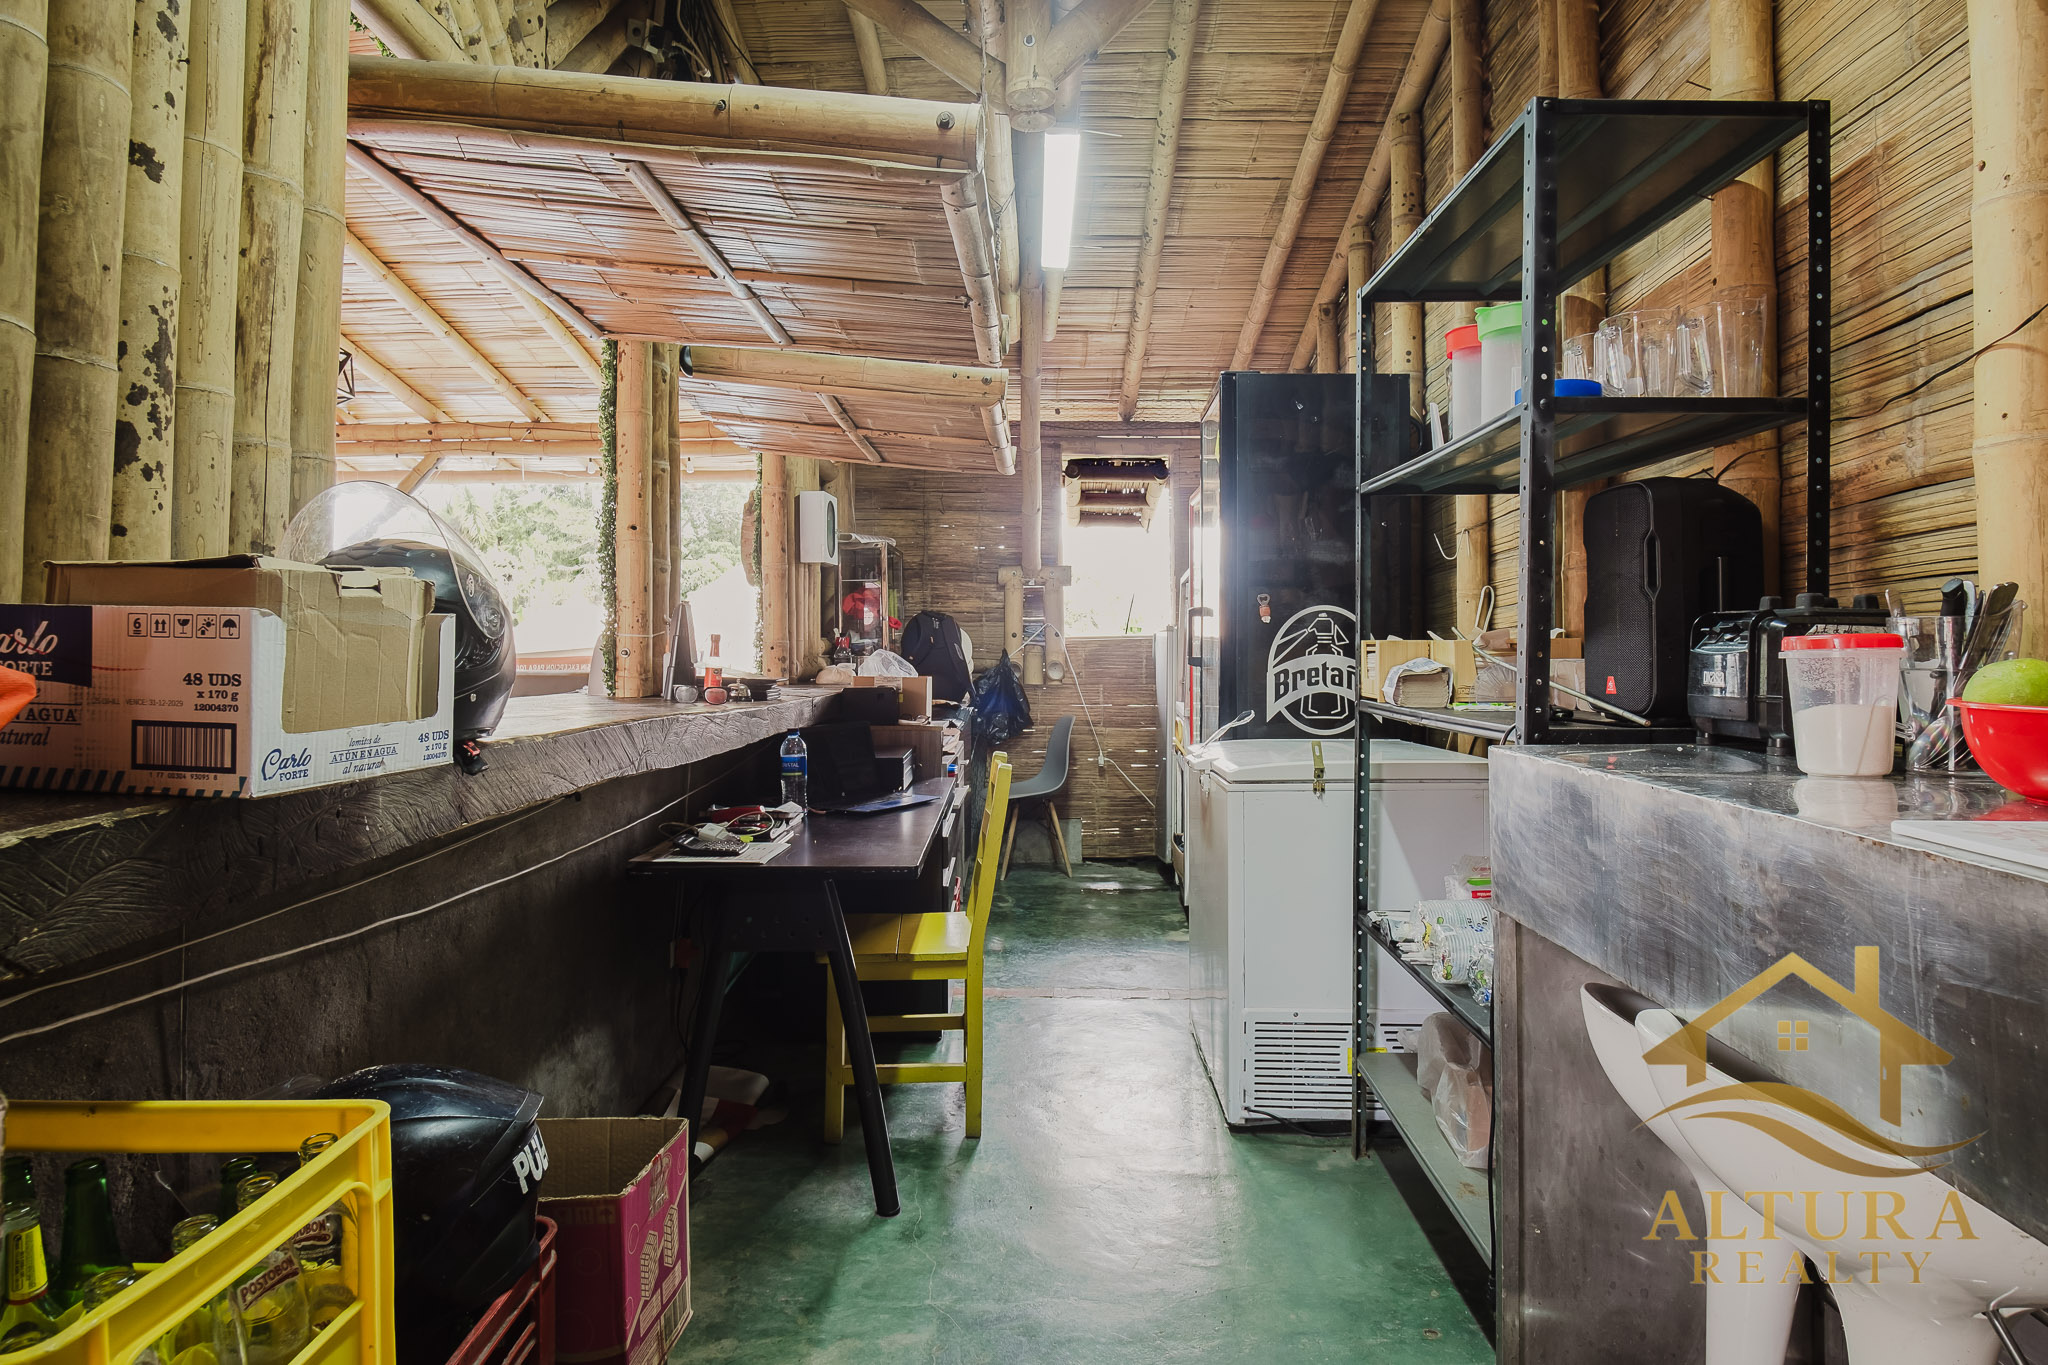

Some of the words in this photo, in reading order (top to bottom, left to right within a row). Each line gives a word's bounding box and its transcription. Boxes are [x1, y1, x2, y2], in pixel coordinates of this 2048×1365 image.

[0, 621, 58, 655] arlo
[0, 661, 53, 676] ORTE
[183, 672, 203, 686] 48
[208, 673, 242, 687] UDS
[1274, 661, 1355, 704] Bretañ
[197, 691, 205, 699] x
[208, 690, 228, 699] 170
[231, 690, 239, 702] g
[25, 708, 77, 722] AGUA
[194, 703, 239, 713] 12004370
[0, 727, 52, 746] atural
[349, 738, 372, 747] lomitos
[373, 735, 381, 744] de
[418, 732, 430, 743] 48
[432, 730, 449, 741] UDS
[431, 742, 442, 751] 170
[331, 750, 359, 763] ATÚN
[360, 750, 373, 760] EN
[375, 746, 397, 756] AGUA
[261, 747, 312, 781] Carlo
[342, 762, 351, 775] al
[353, 757, 385, 773] natural
[279, 769, 309, 781] FORTE
[240, 1254, 296, 1303] POSTOBON
